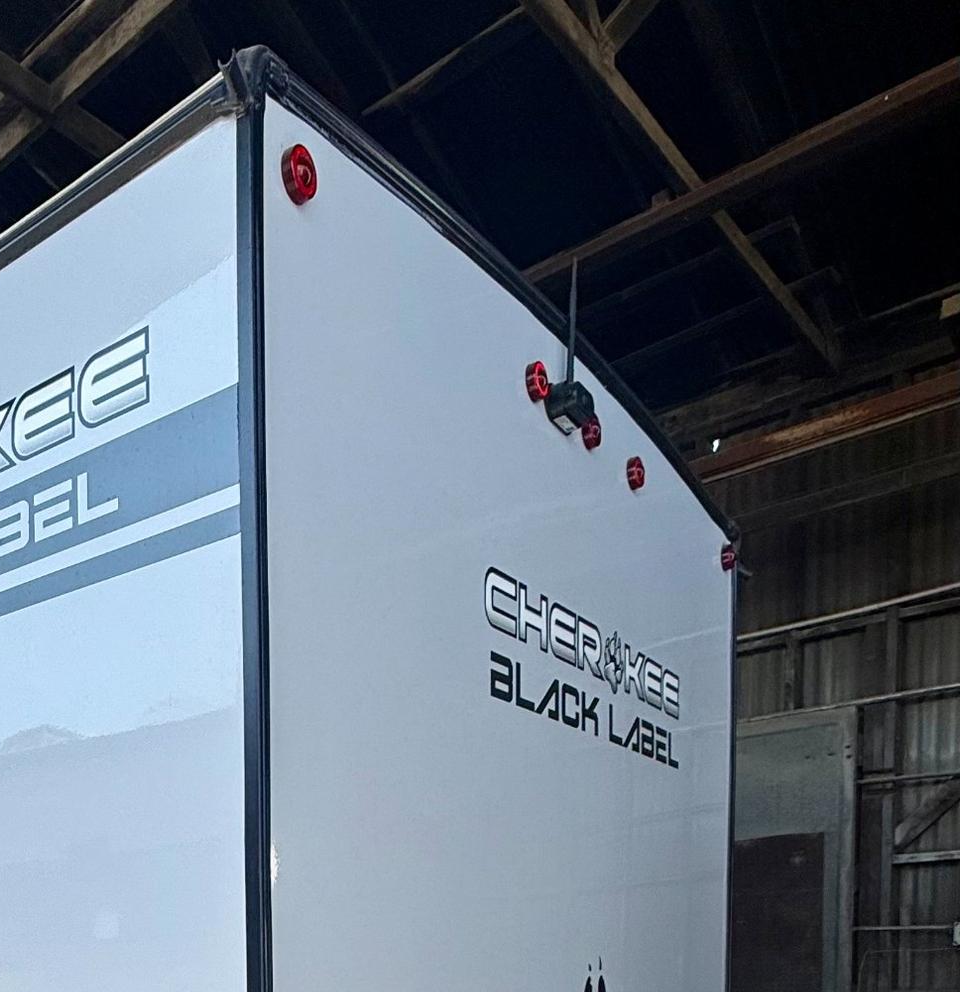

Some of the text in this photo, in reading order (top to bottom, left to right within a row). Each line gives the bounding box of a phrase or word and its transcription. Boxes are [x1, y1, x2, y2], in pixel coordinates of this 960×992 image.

[484, 566, 680, 720] CHERKEE
[490, 650, 679, 769] BLACK LABEL
